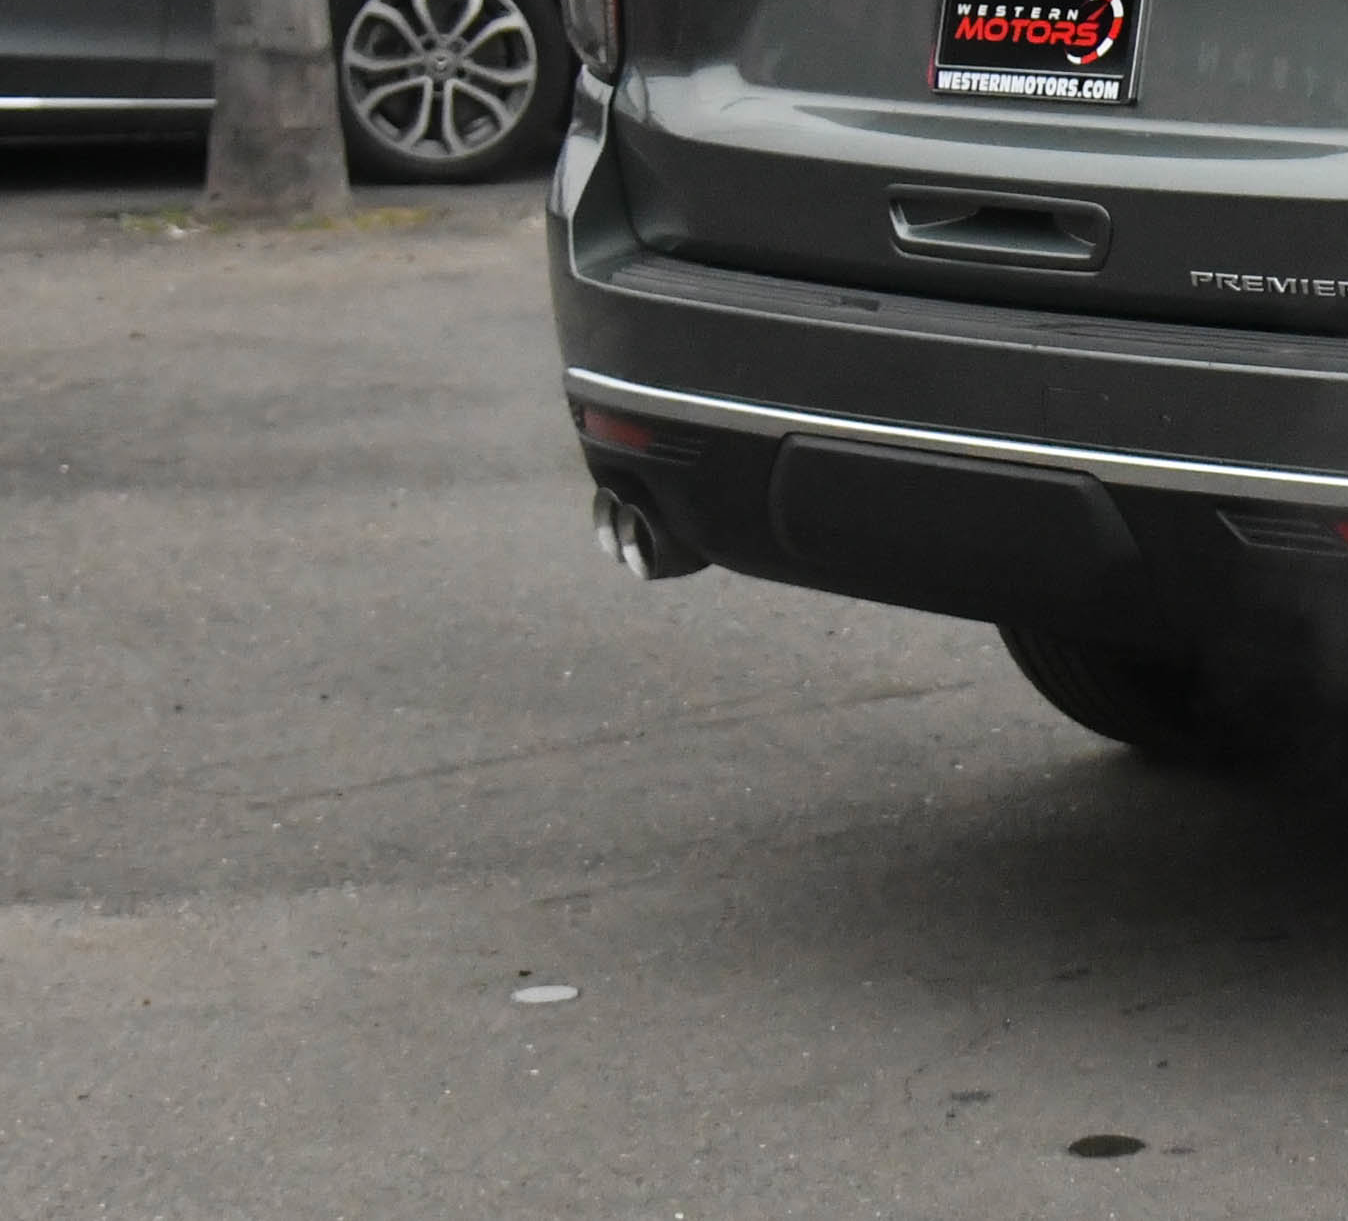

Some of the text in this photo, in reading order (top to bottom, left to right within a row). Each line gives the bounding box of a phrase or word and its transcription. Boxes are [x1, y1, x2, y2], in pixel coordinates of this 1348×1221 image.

[956, 3, 1080, 21] WESTERN
[954, 16, 1100, 47] MOTORS
[937, 70, 1120, 101] WESTERNMOTORS.COM
